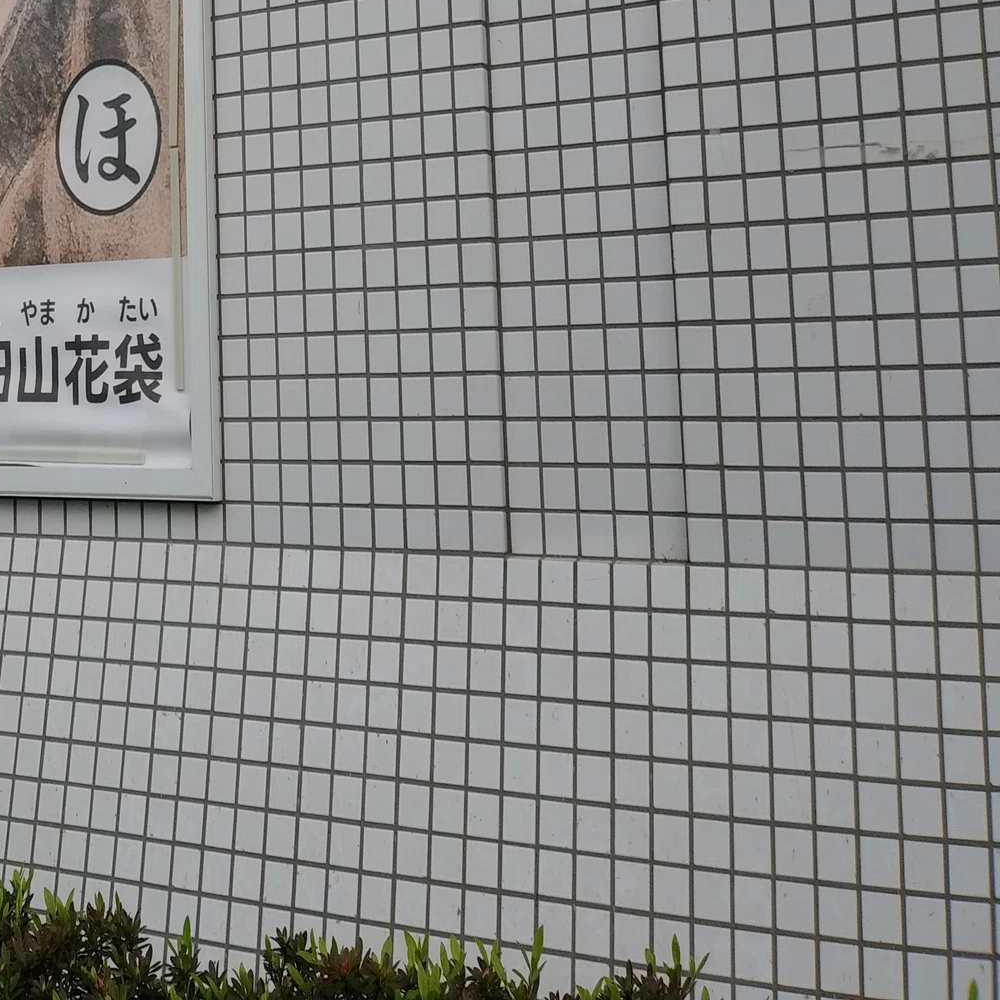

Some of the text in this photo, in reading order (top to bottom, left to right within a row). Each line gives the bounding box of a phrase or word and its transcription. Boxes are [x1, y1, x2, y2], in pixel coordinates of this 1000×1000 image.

[75, 93, 141, 184] ほ
[20, 299, 56, 327] やま
[76, 298, 96, 324] か
[118, 296, 159, 322] たい
